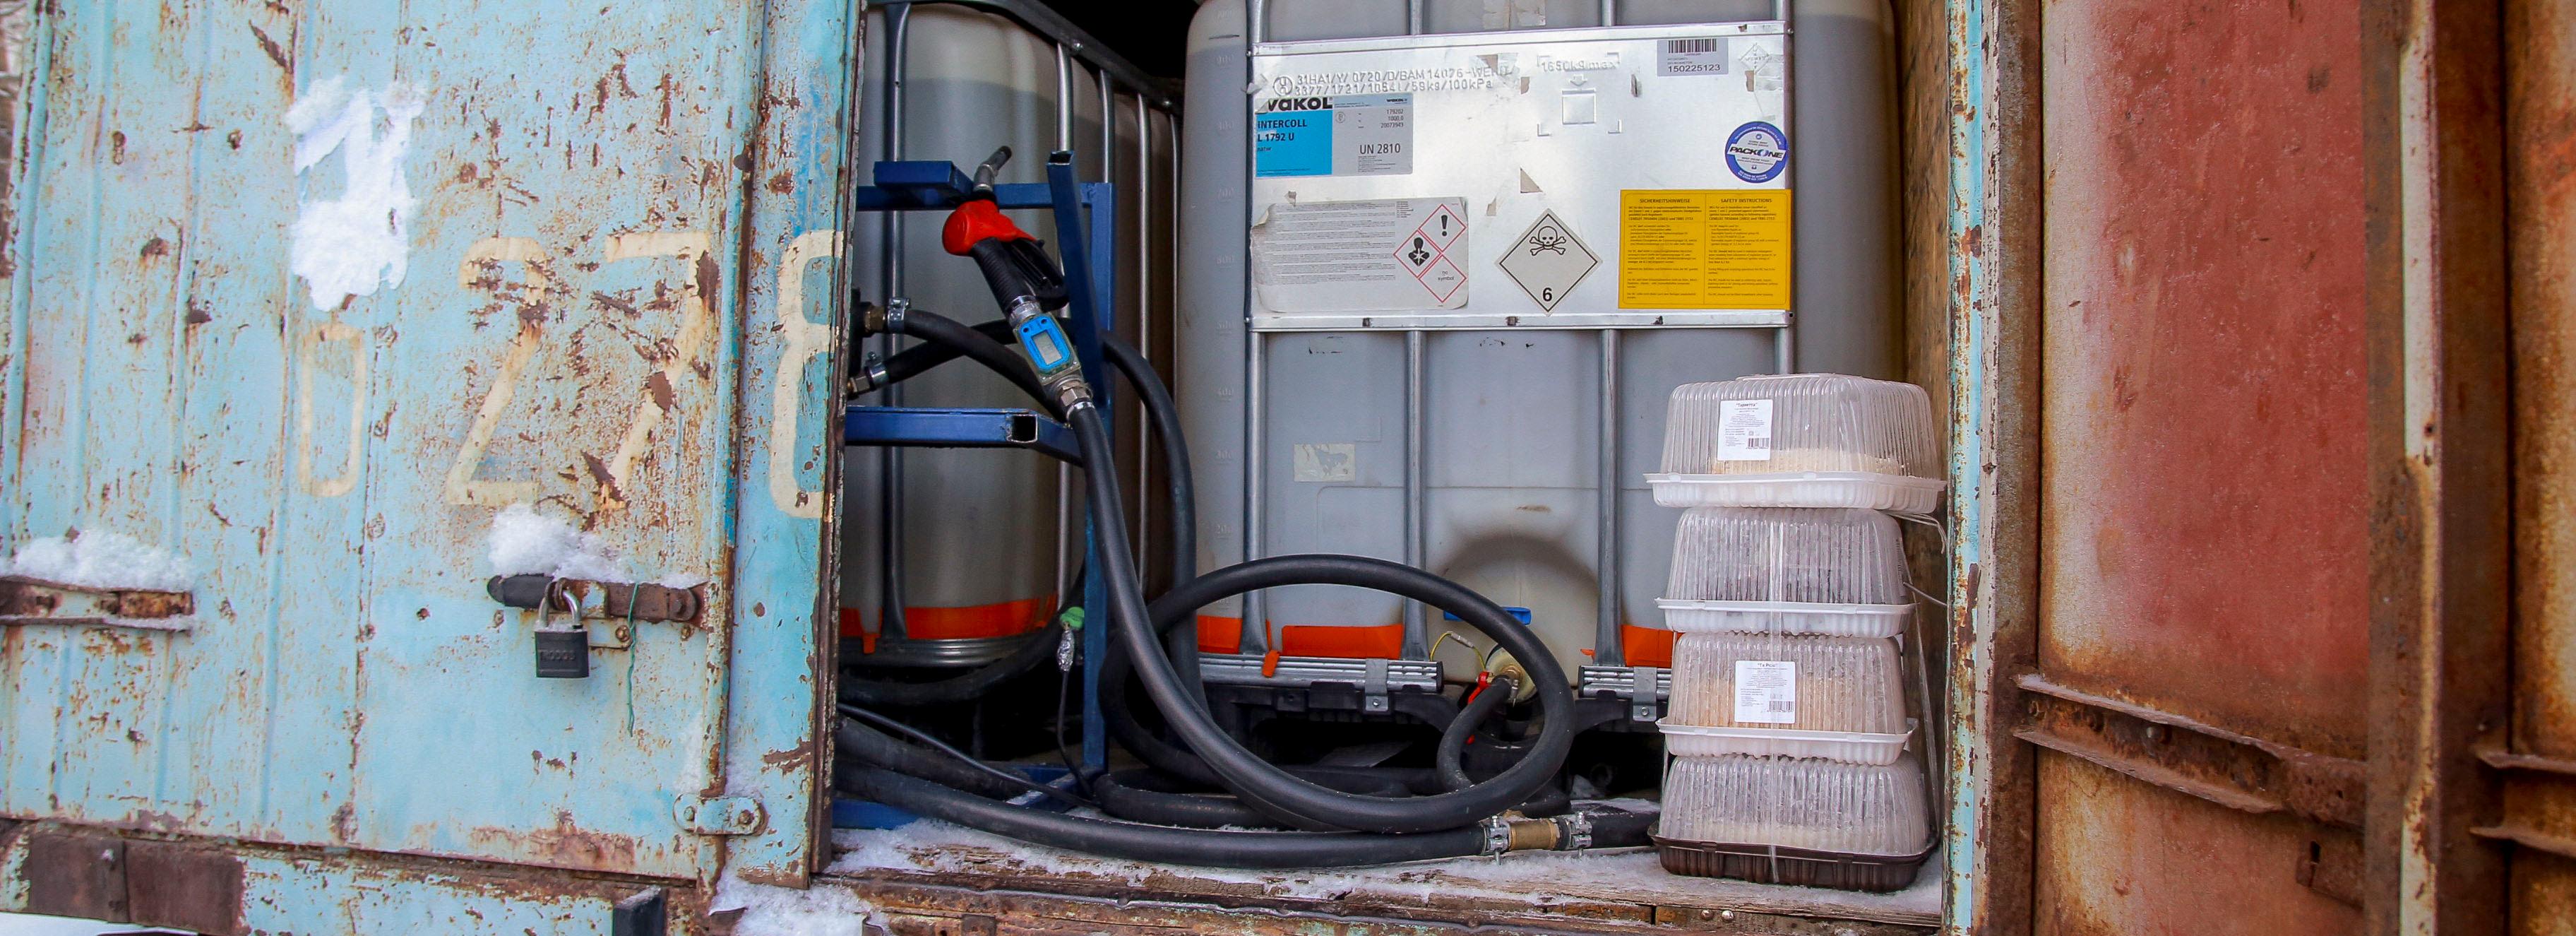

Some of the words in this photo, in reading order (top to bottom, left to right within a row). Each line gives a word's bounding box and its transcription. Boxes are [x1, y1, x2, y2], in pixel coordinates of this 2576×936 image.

[1668, 64, 1721, 73] 150225123
[1258, 119, 1307, 129] INTERCOLL
[1265, 133, 1285, 141] 1792
[1360, 145, 1374, 154] UN
[1378, 143, 1401, 154] 2810
[1729, 146, 1784, 158] PACKONE
[1542, 288, 1552, 302] 6
